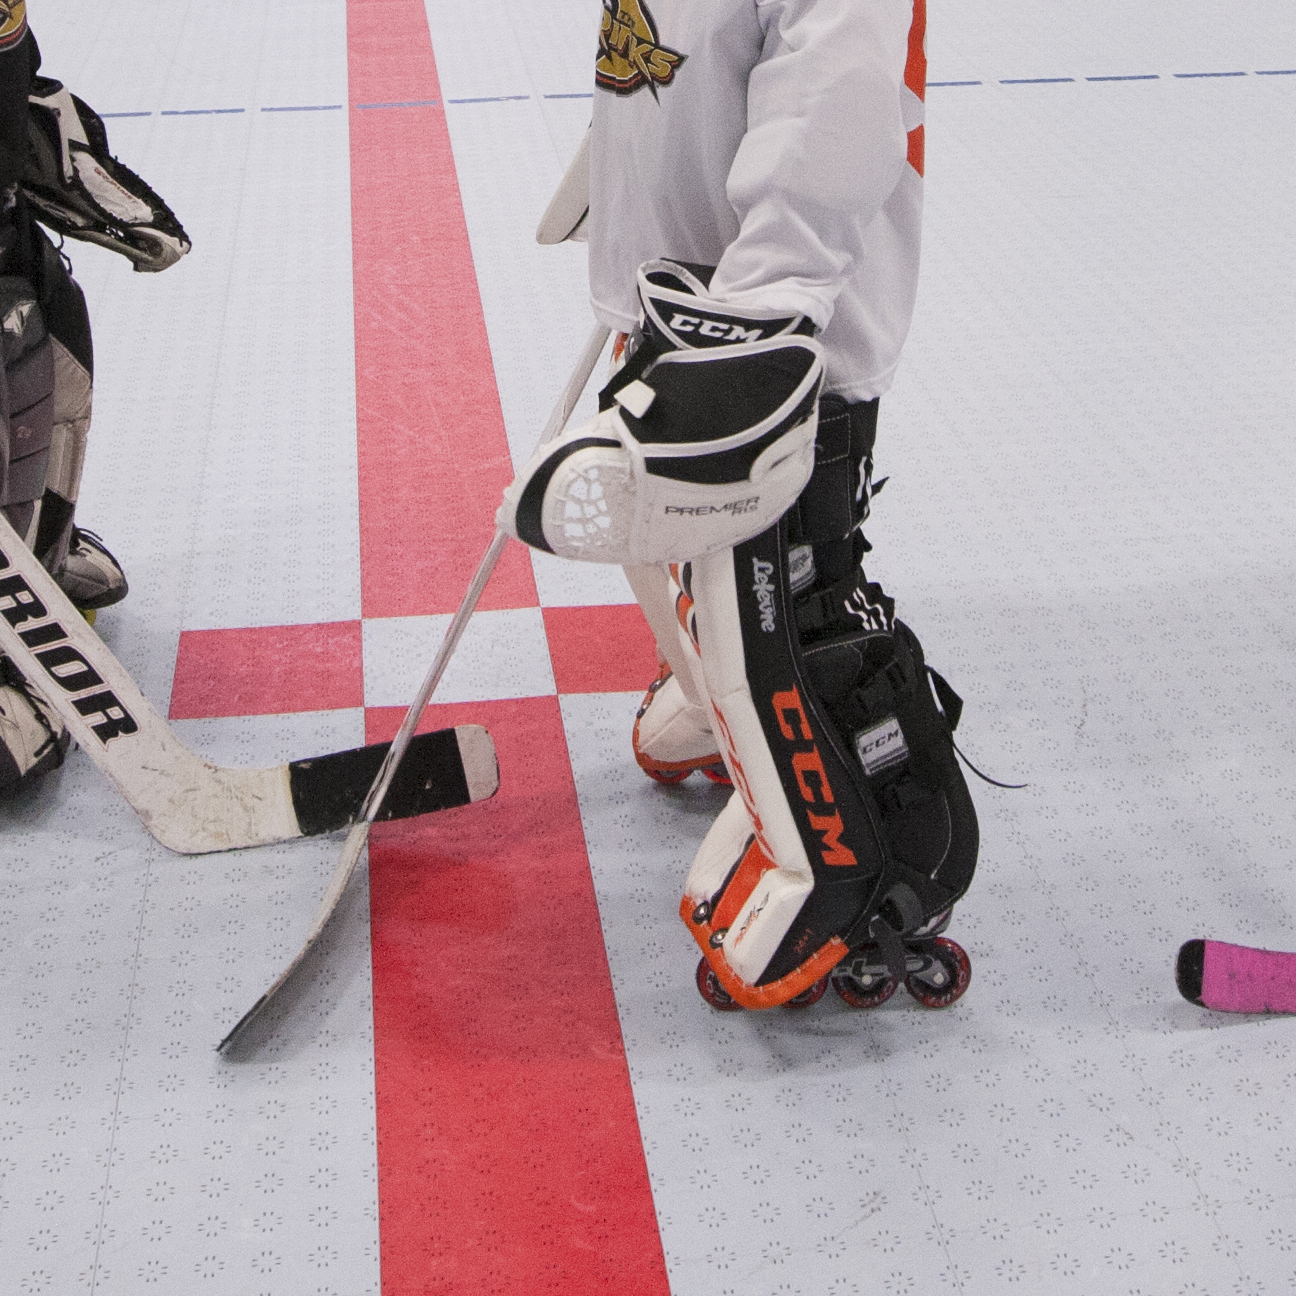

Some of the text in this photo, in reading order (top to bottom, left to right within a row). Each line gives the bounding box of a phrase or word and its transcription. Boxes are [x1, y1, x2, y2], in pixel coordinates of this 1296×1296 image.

[668, 312, 764, 345] CCM
[665, 497, 760, 516] PREMIER
[860, 728, 900, 755] CCM
[771, 682, 858, 867] CCM
